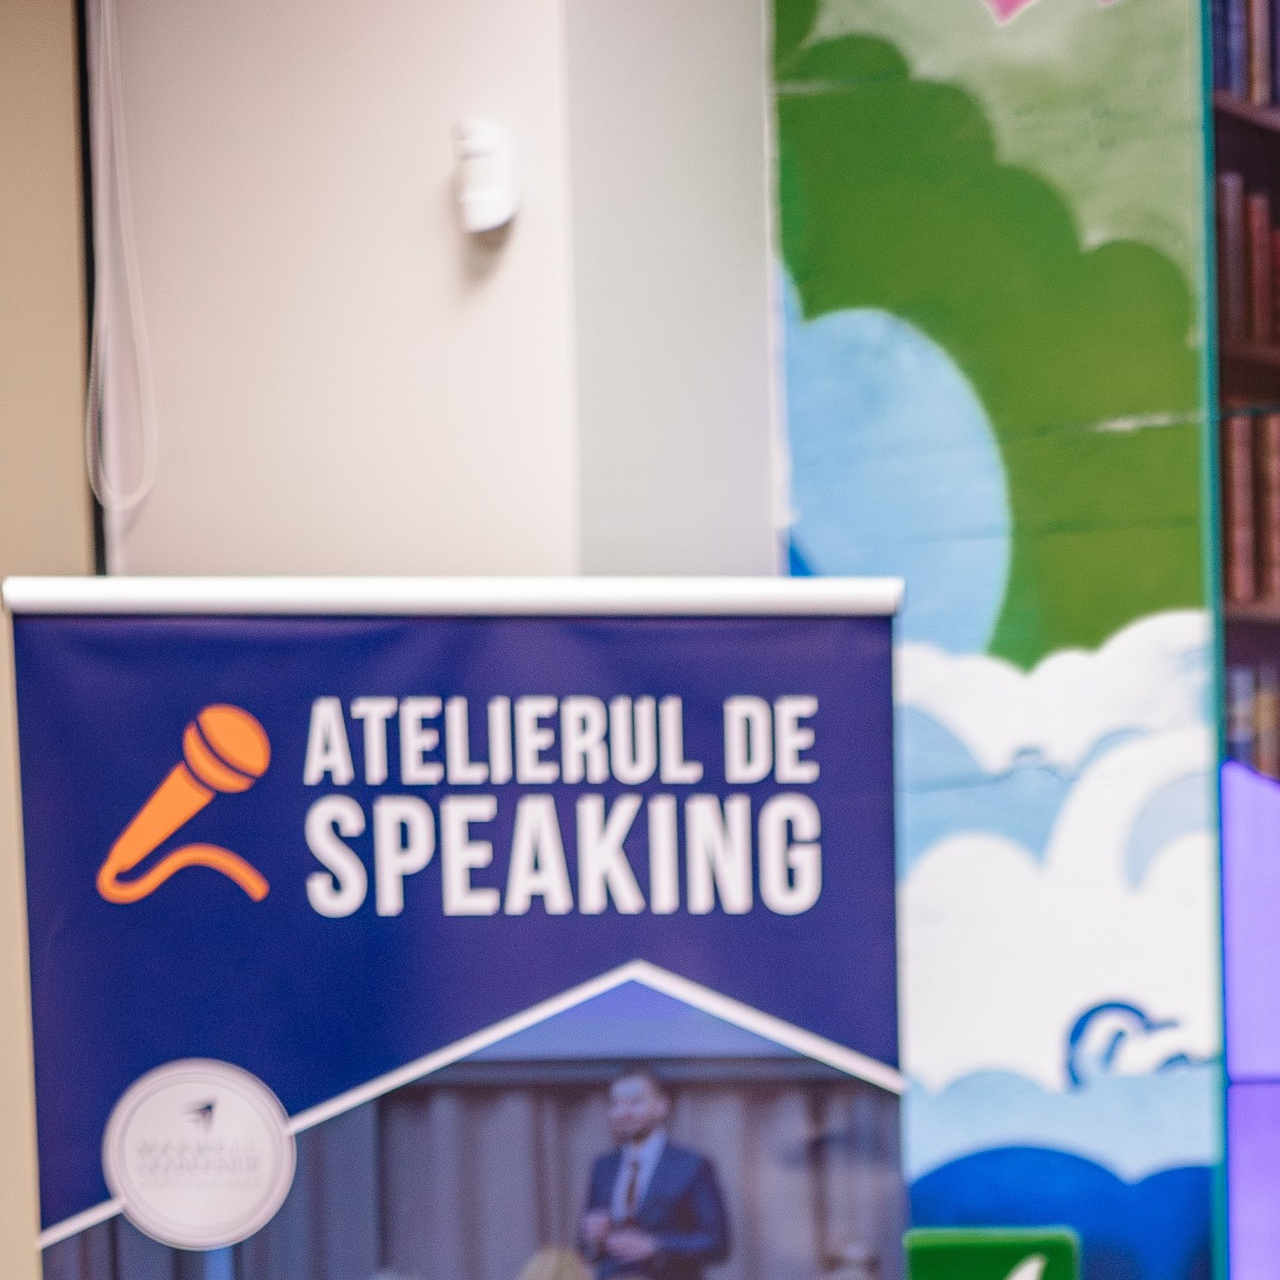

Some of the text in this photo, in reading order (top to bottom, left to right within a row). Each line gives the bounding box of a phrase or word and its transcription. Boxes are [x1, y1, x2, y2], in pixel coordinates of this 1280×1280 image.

[303, 695, 820, 786] ATELIERUL DE
[303, 792, 823, 918] SPEAKING
